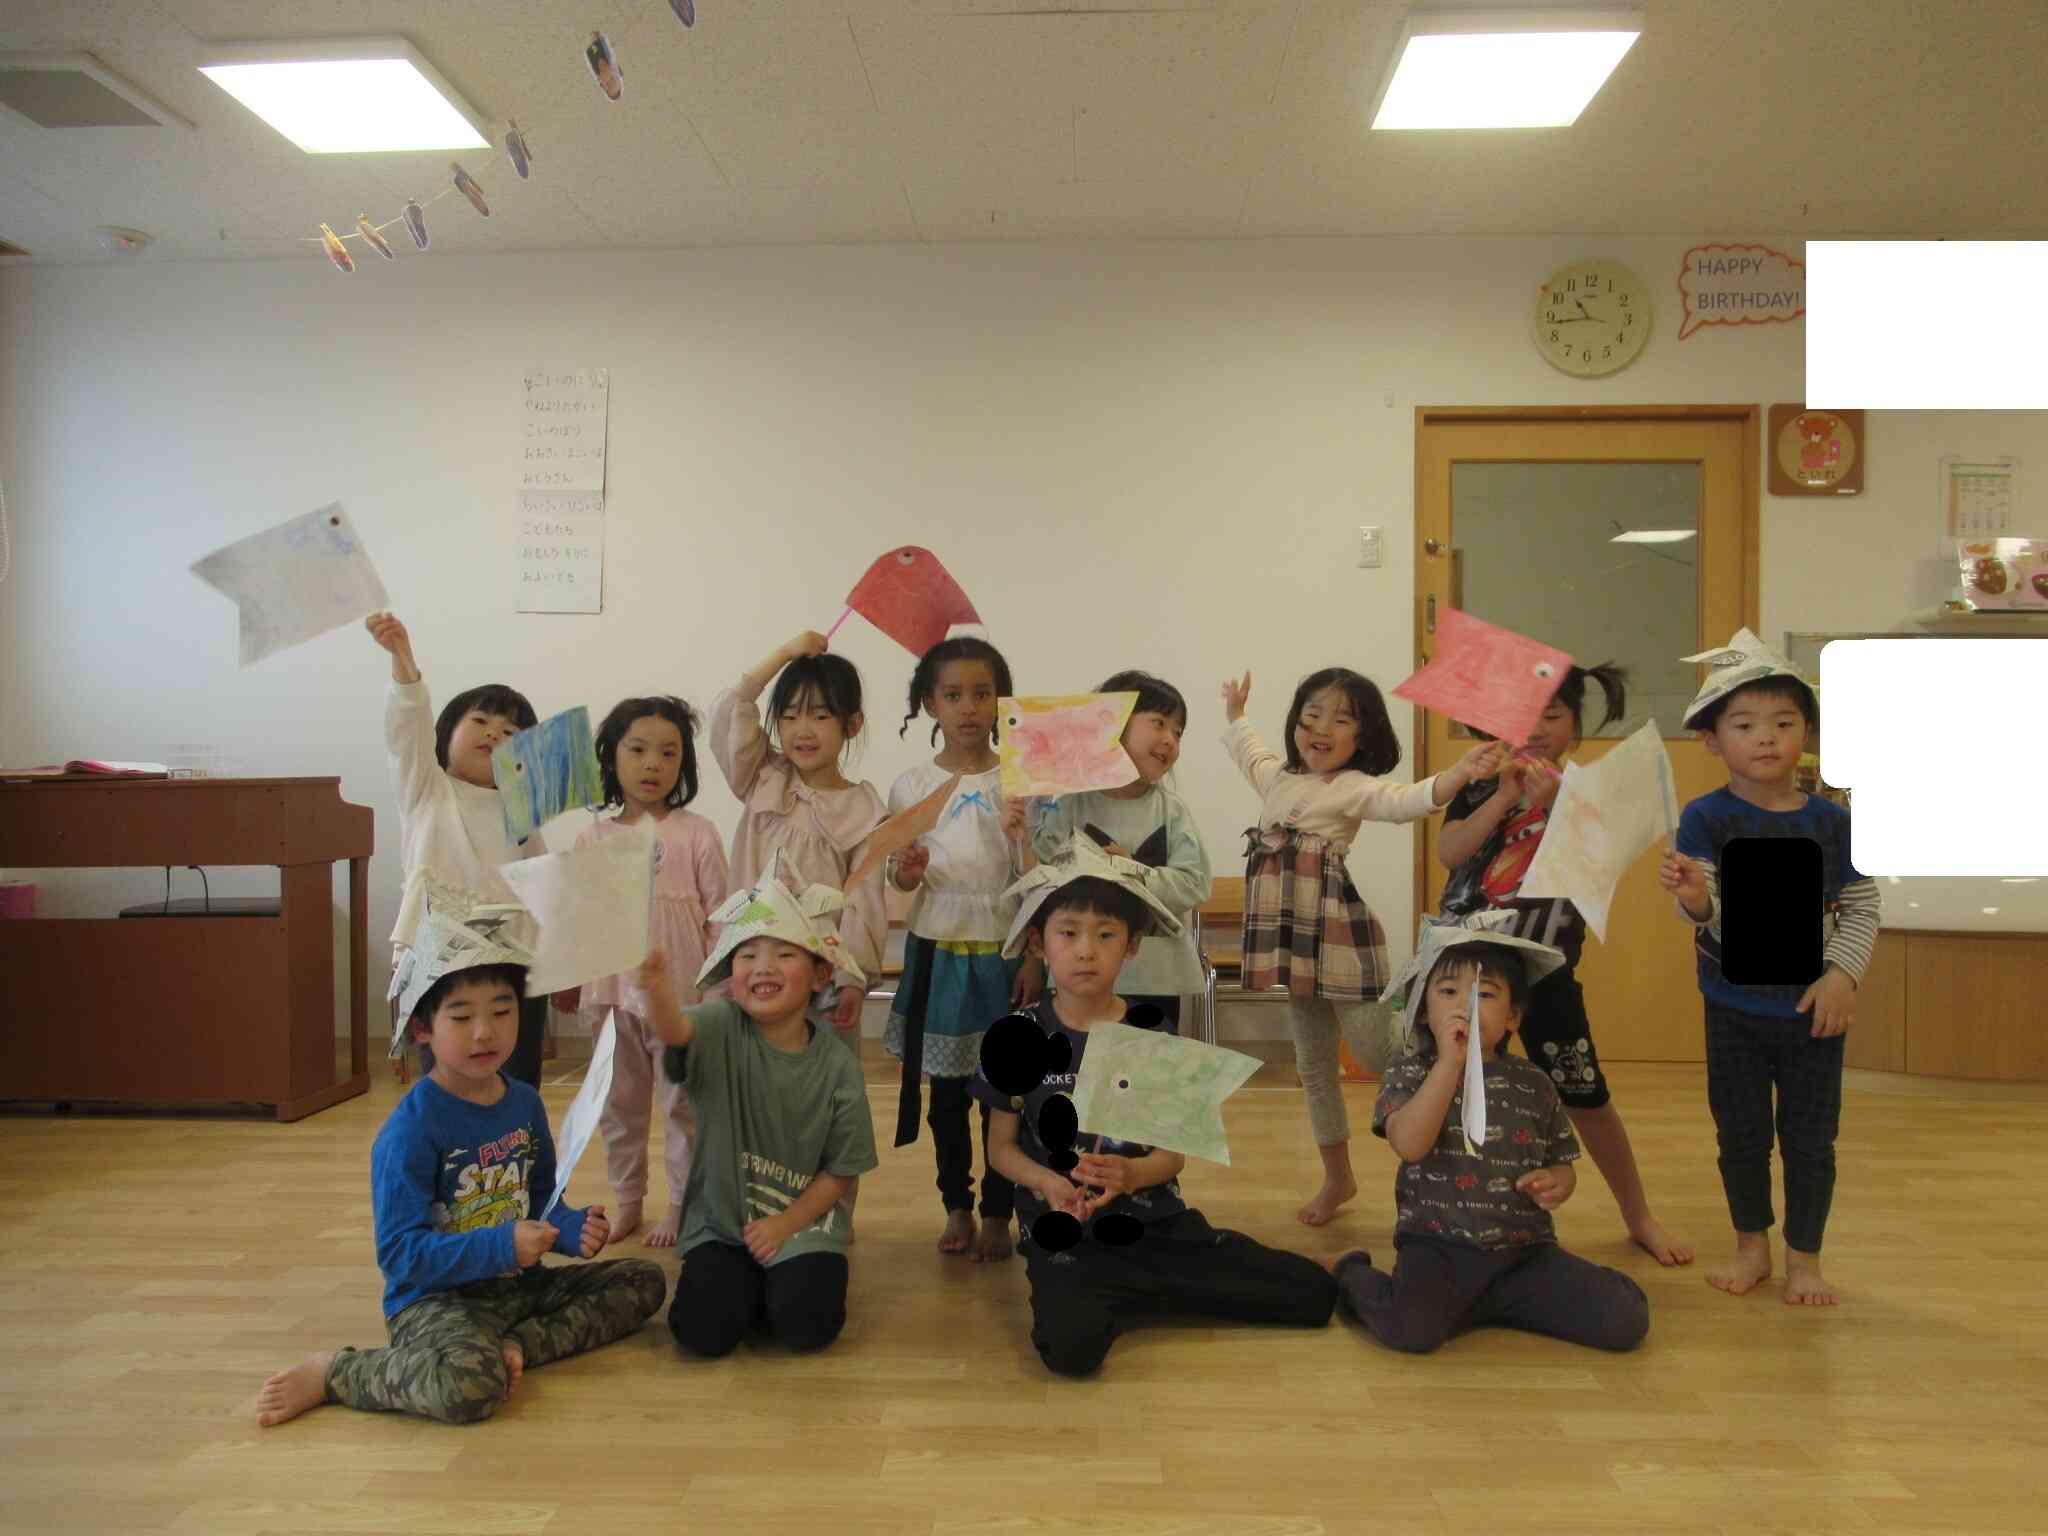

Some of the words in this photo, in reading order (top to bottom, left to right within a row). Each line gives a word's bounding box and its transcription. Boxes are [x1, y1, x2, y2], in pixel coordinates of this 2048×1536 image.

[1697, 257, 1764, 276] HAPPY
[1567, 279, 1576, 292] 11
[1585, 275, 1598, 288] 12
[1607, 280, 1613, 293] 1
[1552, 292, 1564, 305] 10
[1620, 294, 1629, 307] 2
[1697, 291, 1801, 310] BIRTHDAY!
[1546, 311, 1555, 323] 9
[1624, 313, 1632, 325] 3
[1550, 330, 1559, 342] 8
[1616, 332, 1624, 344] 4
[1564, 344, 1572, 357] 7
[1582, 350, 1591, 363] 6
[1602, 346, 1611, 359] 5
